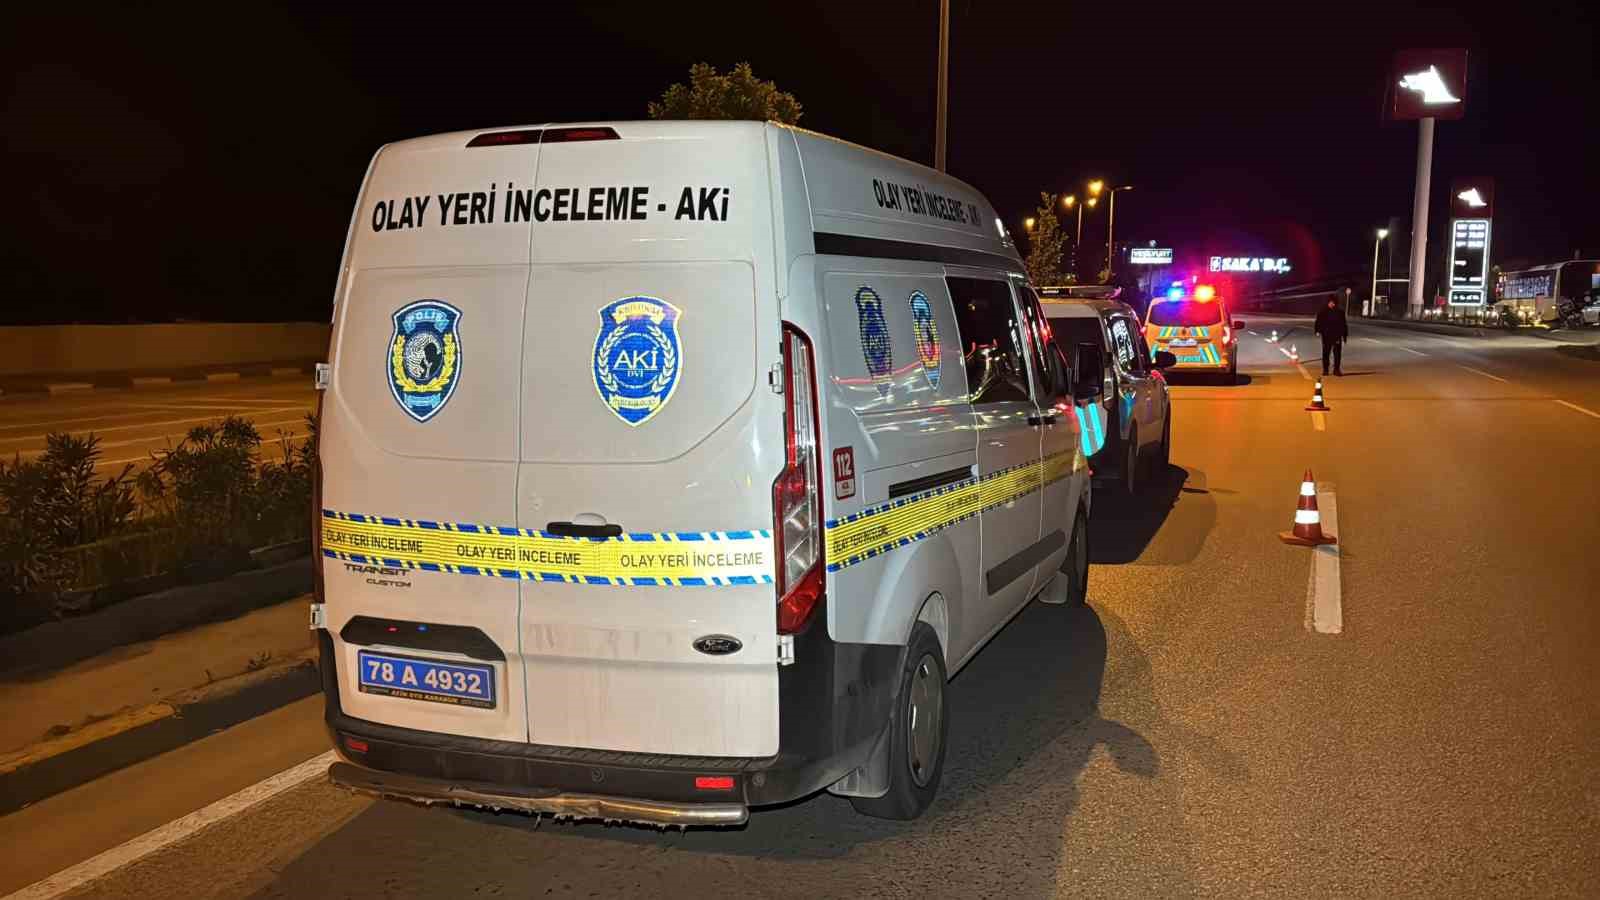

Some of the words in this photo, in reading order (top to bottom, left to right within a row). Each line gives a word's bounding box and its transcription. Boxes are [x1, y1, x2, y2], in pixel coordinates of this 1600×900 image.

[873, 178, 902, 211] OLAY
[372, 196, 430, 232] OLAY
[438, 183, 496, 226] YERİ
[504, 182, 649, 223] İNCELEME
[613, 347, 659, 369] AKİ
[837, 453, 852, 477] 112
[327, 530, 346, 544] OLAY
[457, 545, 487, 558] OLAY
[490, 545, 516, 561] YERİ
[519, 545, 581, 565] İNCELEME
[620, 554, 655, 568] OLAY
[659, 552, 689, 568] YERİ
[693, 552, 763, 567] İNCELEME
[344, 563, 410, 576] TRANSIT
[366, 578, 412, 588] CUSTOM
[367, 660, 395, 682] 78
[401, 665, 418, 687] A
[424, 669, 482, 694] 4932
